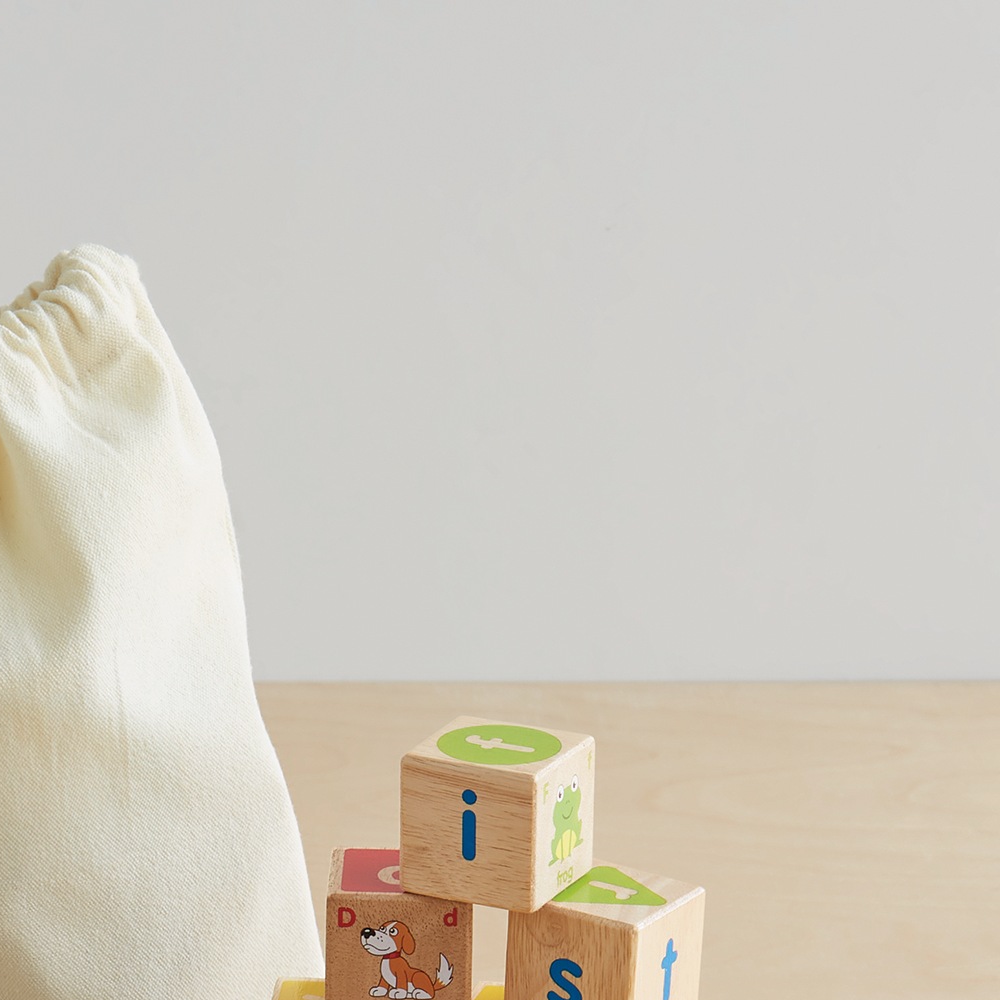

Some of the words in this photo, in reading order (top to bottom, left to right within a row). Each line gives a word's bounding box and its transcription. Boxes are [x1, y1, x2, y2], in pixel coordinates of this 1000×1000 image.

[461, 789, 477, 861] i
[556, 866, 574, 887] frog
[337, 907, 356, 928] D
[443, 907, 458, 927] d
